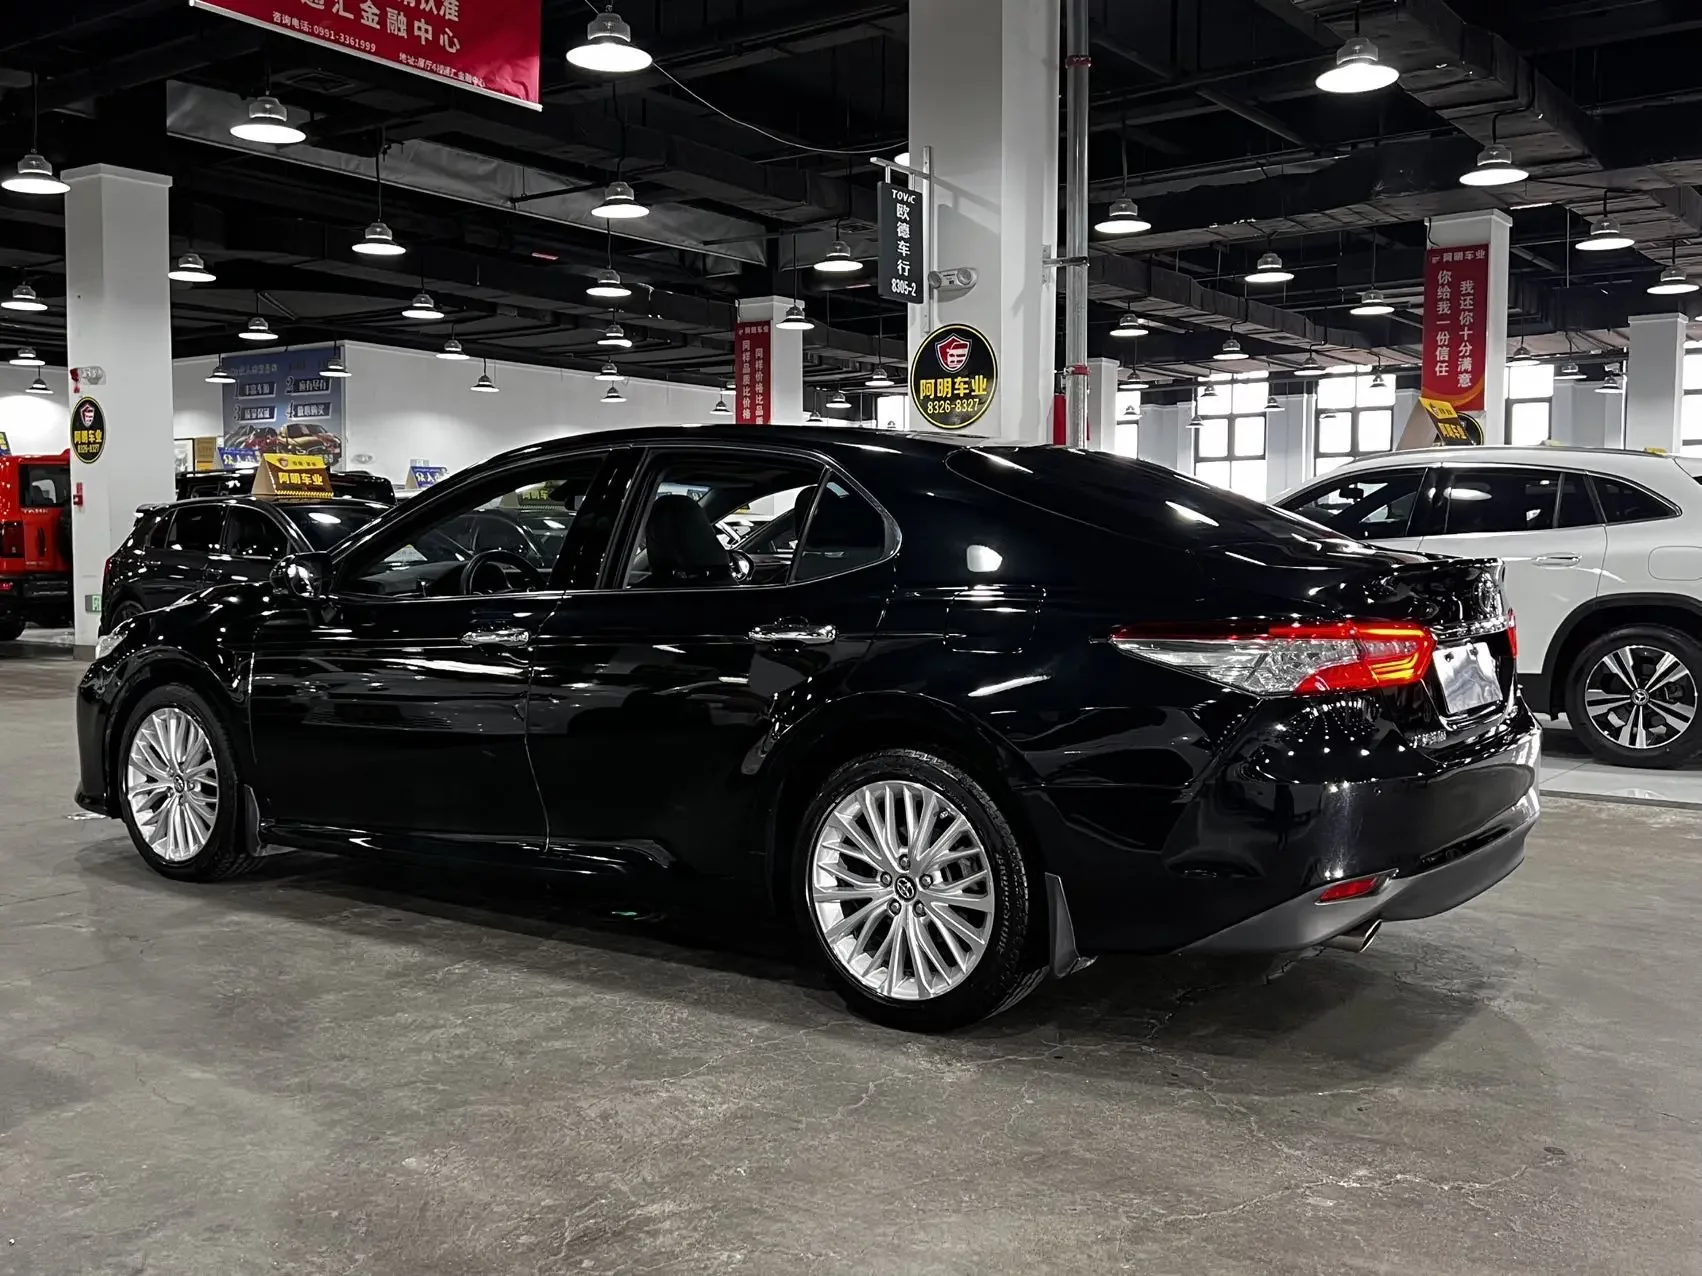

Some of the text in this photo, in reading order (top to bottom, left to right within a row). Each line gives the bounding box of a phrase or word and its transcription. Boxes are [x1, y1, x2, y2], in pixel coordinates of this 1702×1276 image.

[896, 202, 911, 276] 欧德车行
[891, 278, 917, 297] 8305-2
[1435, 270, 1452, 377] 你给我一份信任
[1457, 280, 1475, 388] 我还你十分满意
[920, 374, 987, 400] 阿明车业
[927, 398, 980, 414] 8326-8327
[278, 472, 323, 486] 阿明车业
